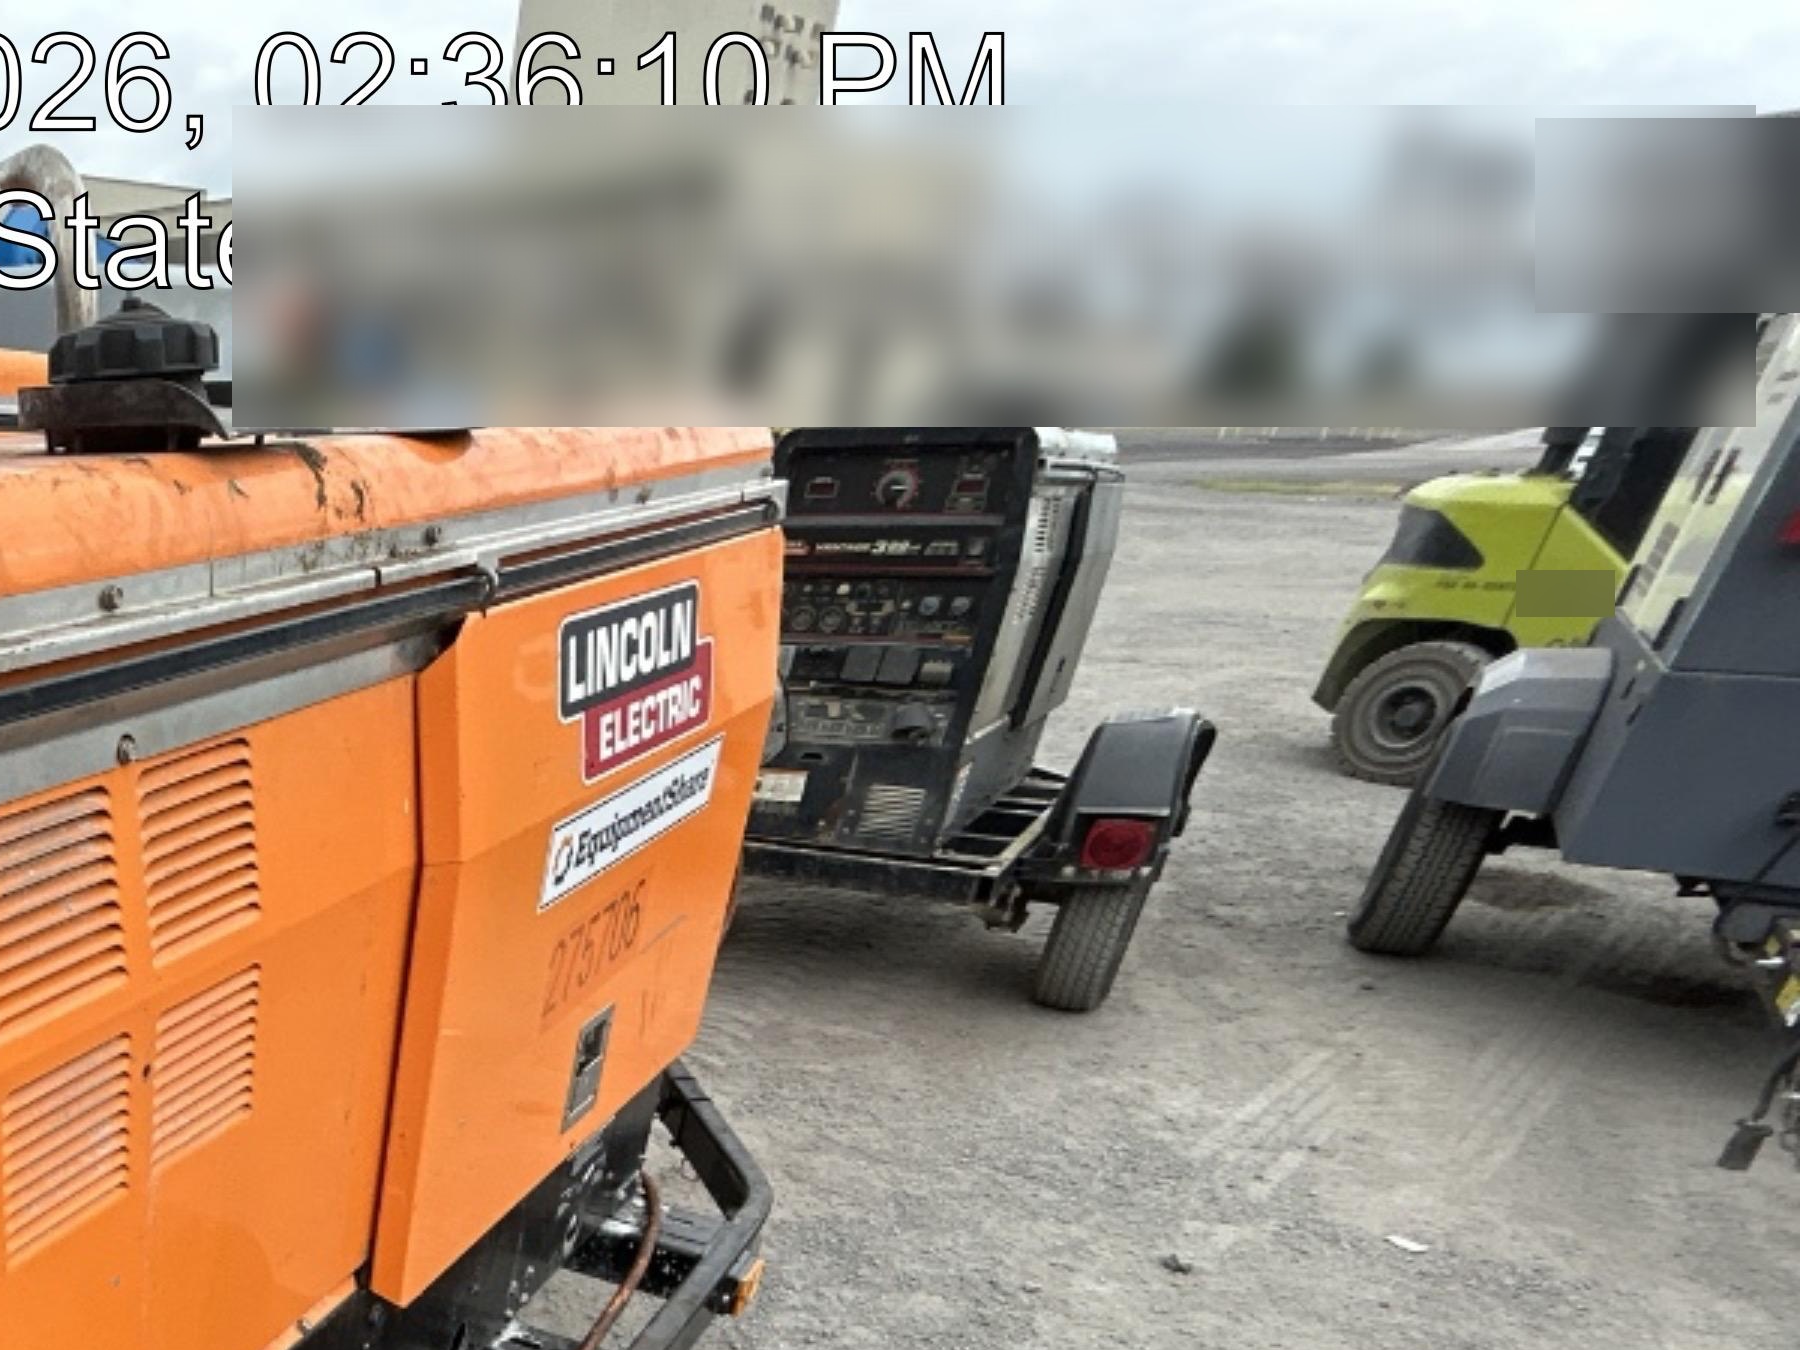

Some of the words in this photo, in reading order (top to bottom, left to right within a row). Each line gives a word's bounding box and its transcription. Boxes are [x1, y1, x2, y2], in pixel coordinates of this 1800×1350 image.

[567, 599, 694, 705] LINCOLN
[599, 674, 702, 761] ELECTRIC
[574, 766, 711, 868] EquipmentShare
